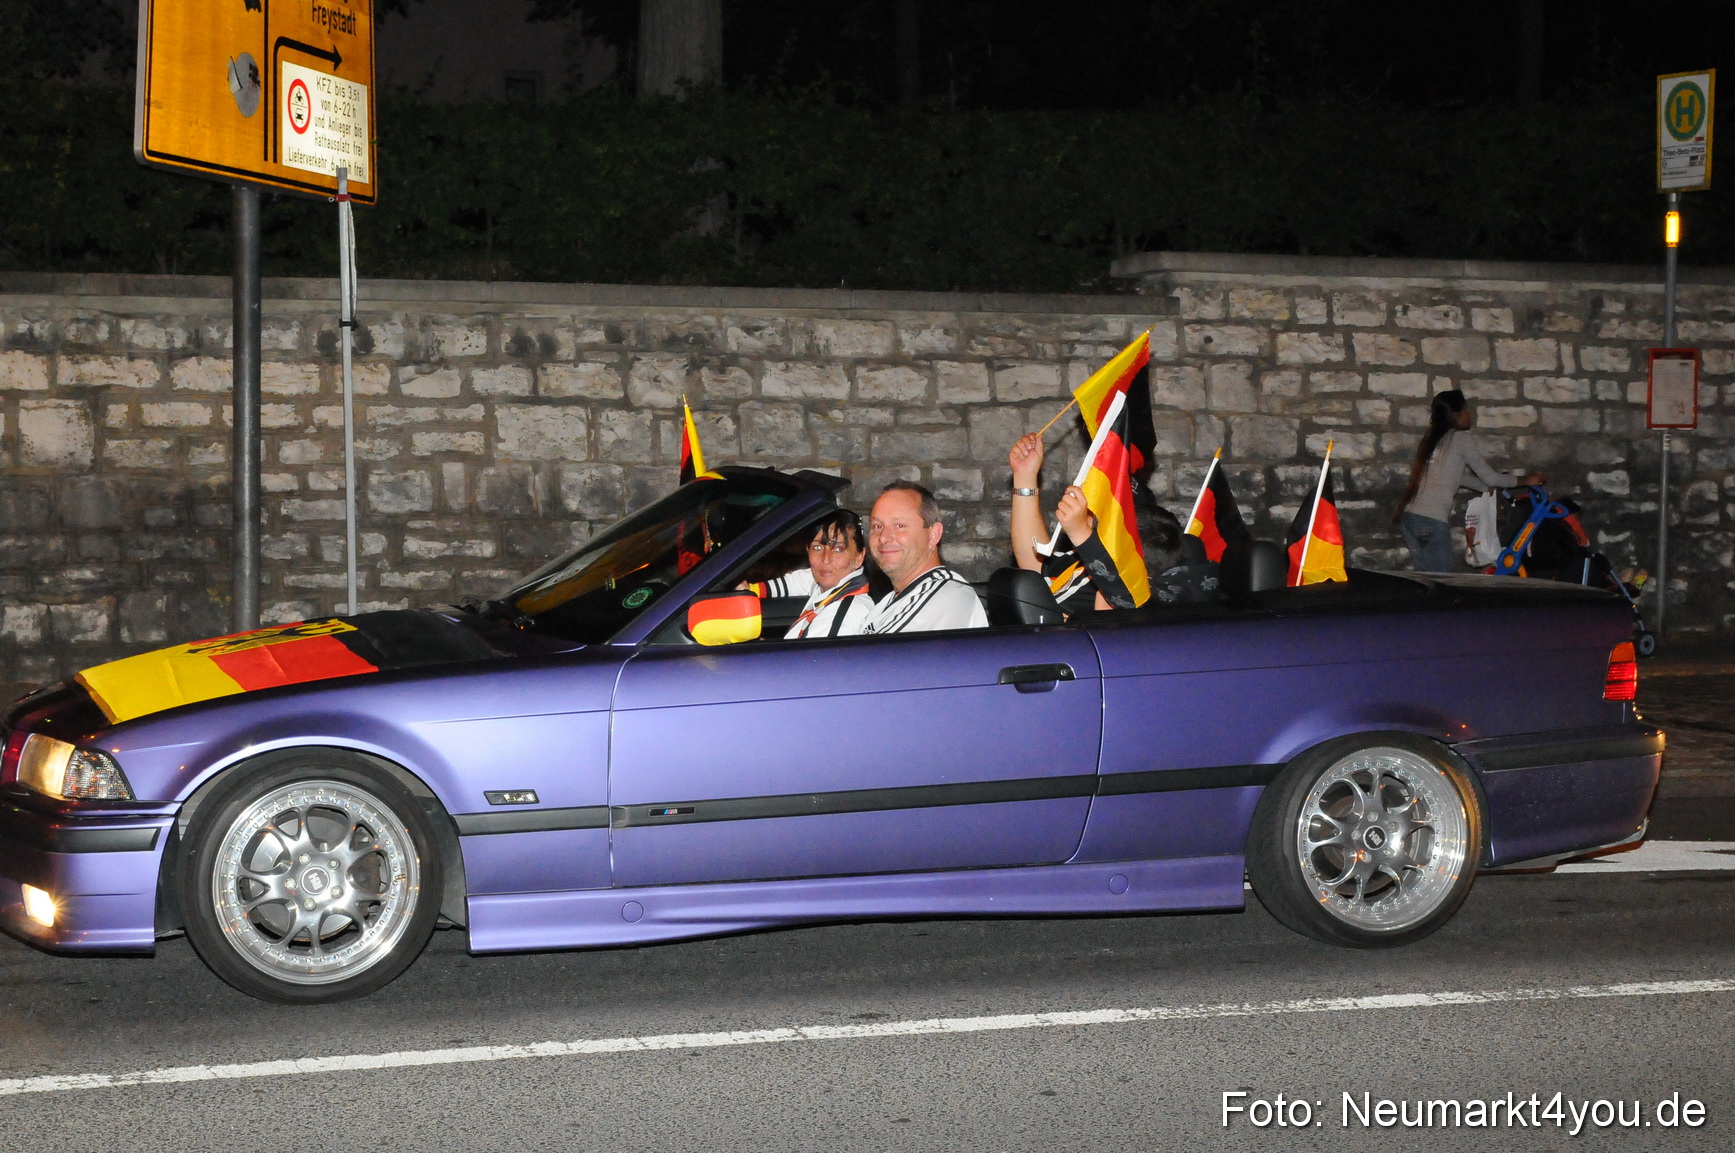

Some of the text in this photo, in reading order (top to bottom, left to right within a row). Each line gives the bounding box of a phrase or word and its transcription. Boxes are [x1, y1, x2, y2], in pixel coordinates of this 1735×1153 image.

[312, 0, 357, 37] Freystadt
[316, 75, 332, 94] KFZ
[334, 80, 346, 98] bis
[320, 98, 331, 112] von
[328, 115, 352, 138] Anlieger
[354, 122, 363, 138] bis
[314, 131, 364, 157] Rathausplatz frei
[288, 146, 328, 169] Lieferverkehr
